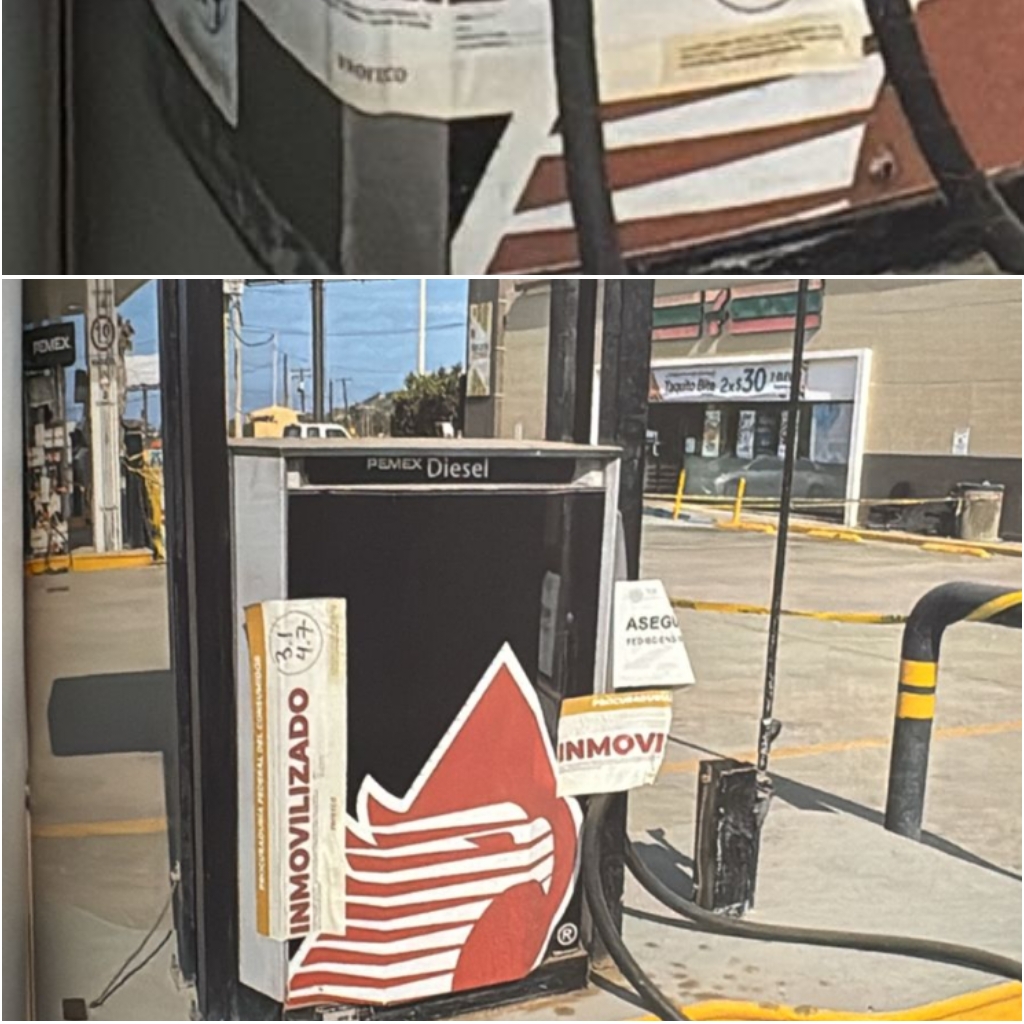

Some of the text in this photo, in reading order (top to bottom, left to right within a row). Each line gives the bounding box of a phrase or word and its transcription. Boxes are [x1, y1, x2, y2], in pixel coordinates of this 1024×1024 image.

[33, 336, 72, 355] PEMEX
[367, 457, 489, 479] PEMEX Diesel
[287, 687, 311, 935] INMOVILIZADO
